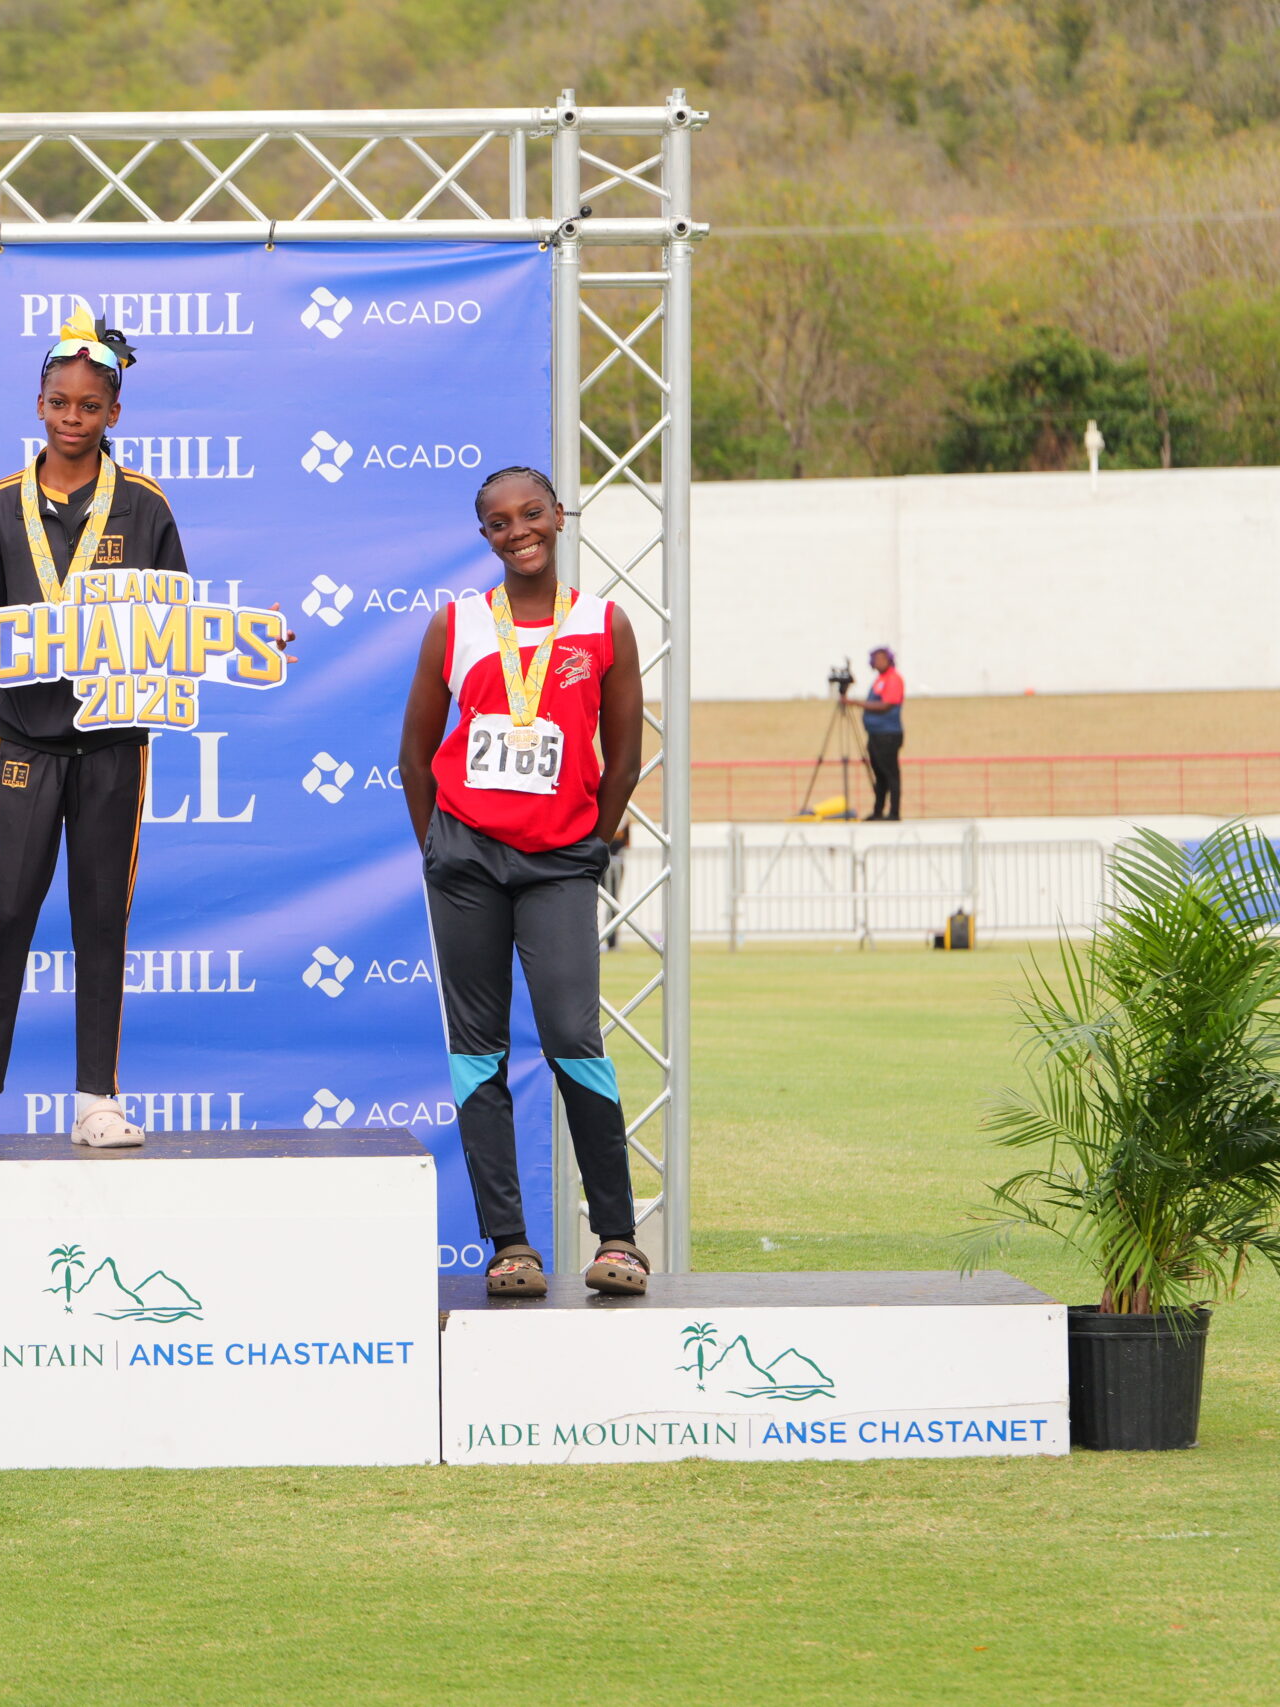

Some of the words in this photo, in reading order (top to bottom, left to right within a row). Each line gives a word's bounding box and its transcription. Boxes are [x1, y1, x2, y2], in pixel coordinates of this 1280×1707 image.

[362, 300, 482, 325] ACADO
[21, 436, 254, 480] PEHILL
[363, 444, 482, 469] ACADO
[74, 573, 190, 605] ISLAND
[76, 674, 195, 726] 2026
[22, 950, 256, 993] PIEHILL
[364, 959, 433, 983] ACA
[365, 1102, 457, 1126] ACAD
[129, 1344, 213, 1366] ANSE
[225, 1341, 414, 1366] CHASTANET
[466, 1423, 540, 1452] JADE
[552, 1422, 736, 1446] MOUNTAIN
[762, 1421, 847, 1444] ANSE
[858, 1419, 1048, 1443] CHASTANET
